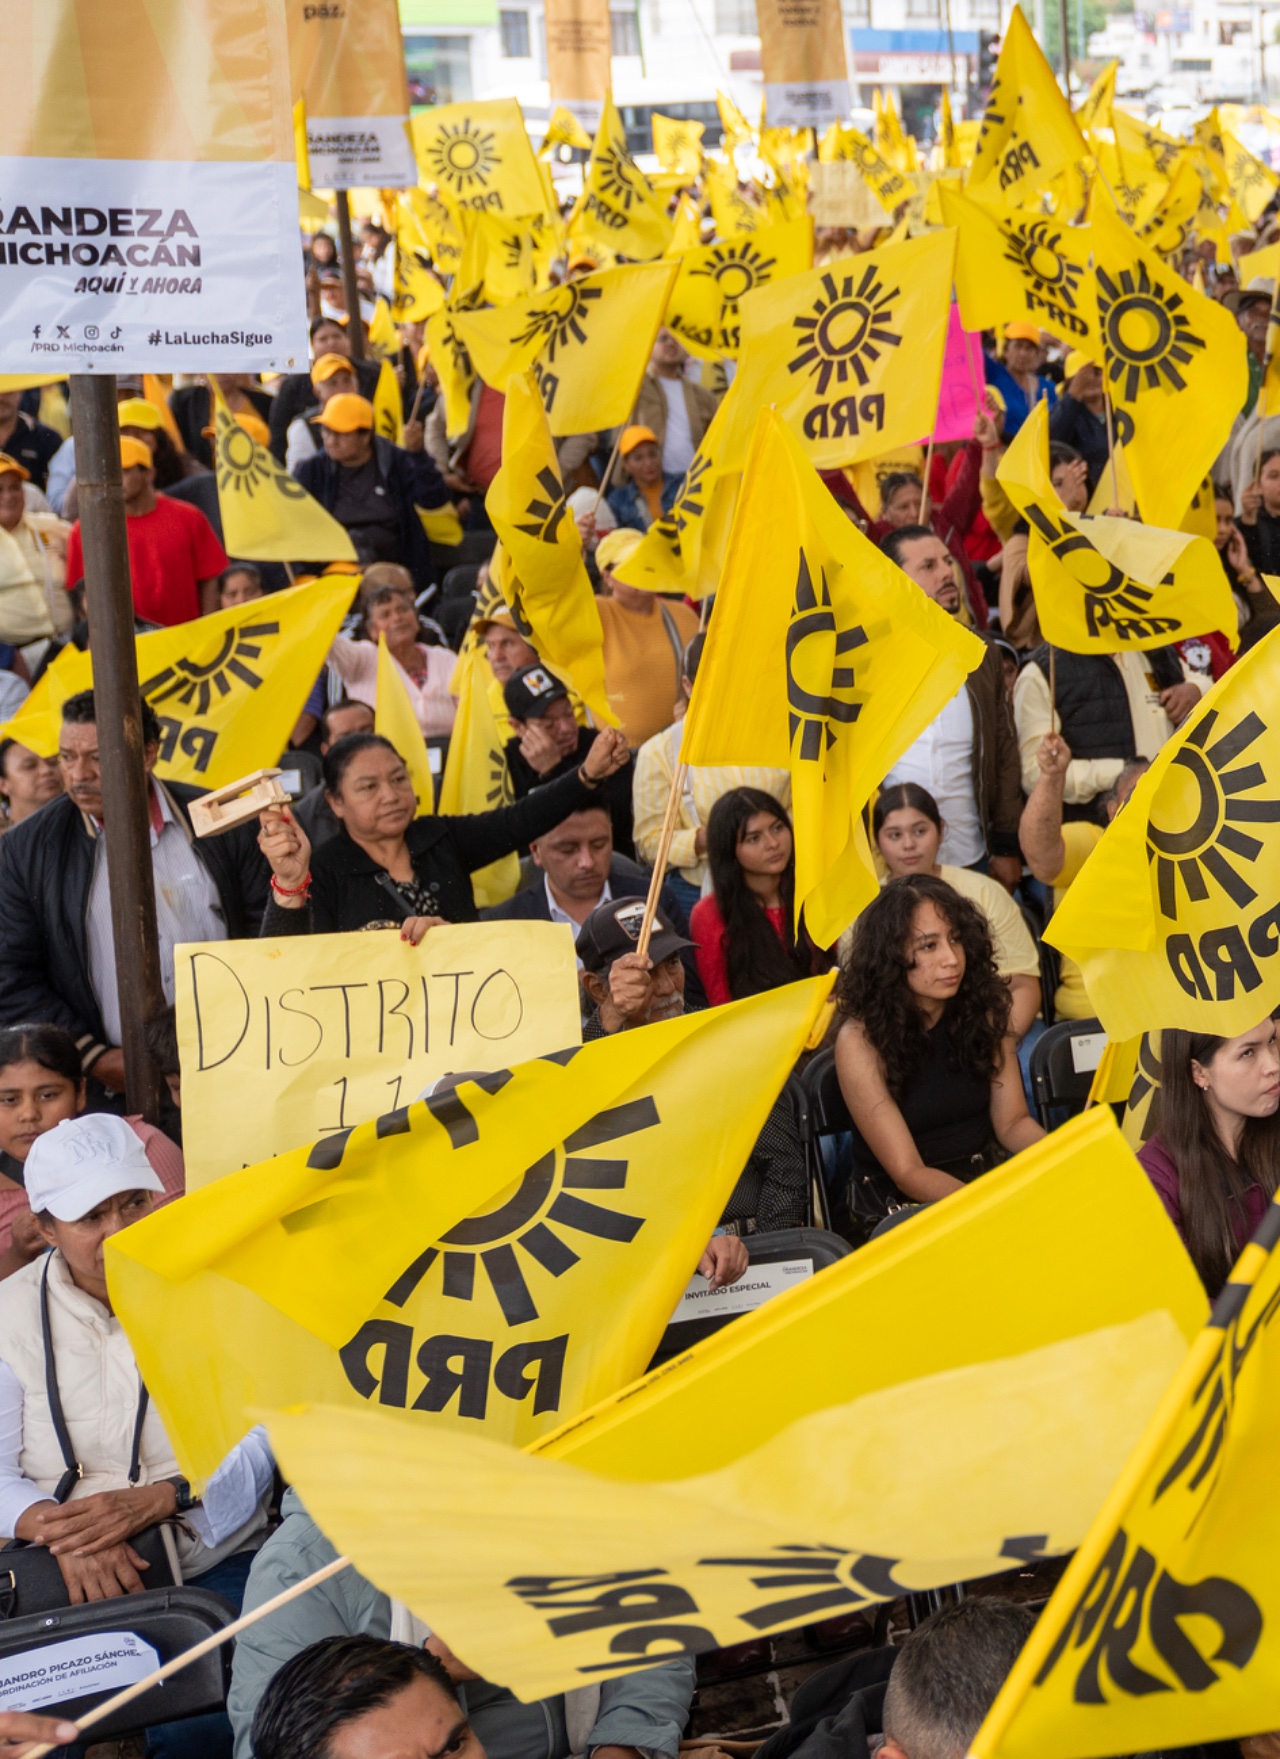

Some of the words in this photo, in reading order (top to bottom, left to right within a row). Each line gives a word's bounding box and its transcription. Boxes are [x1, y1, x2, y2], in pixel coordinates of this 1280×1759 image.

[0, 206, 199, 238] ANDEZA
[583, 194, 628, 230] PRD
[0, 232, 201, 267] ICHOACÁN
[125, 276, 138, 295] Y
[141, 277, 202, 295] AHORA
[1025, 289, 1088, 337] PRD
[63, 341, 125, 352] Michoacán
[148, 329, 273, 347] #LaLuchaSigue
[1084, 592, 1181, 640] PRD
[190, 951, 523, 1072] DISTRITO
[318, 1075, 403, 1132] 11
[685, 1287, 728, 1301] INVITADO
[729, 1281, 772, 1293] ESPECIAL
[1033, 1526, 1264, 1706] PRD
[49, 1656, 92, 1677] PICAZO
[55, 1671, 67, 1682] DE
[69, 1660, 117, 1679] AFILIACIÓN
